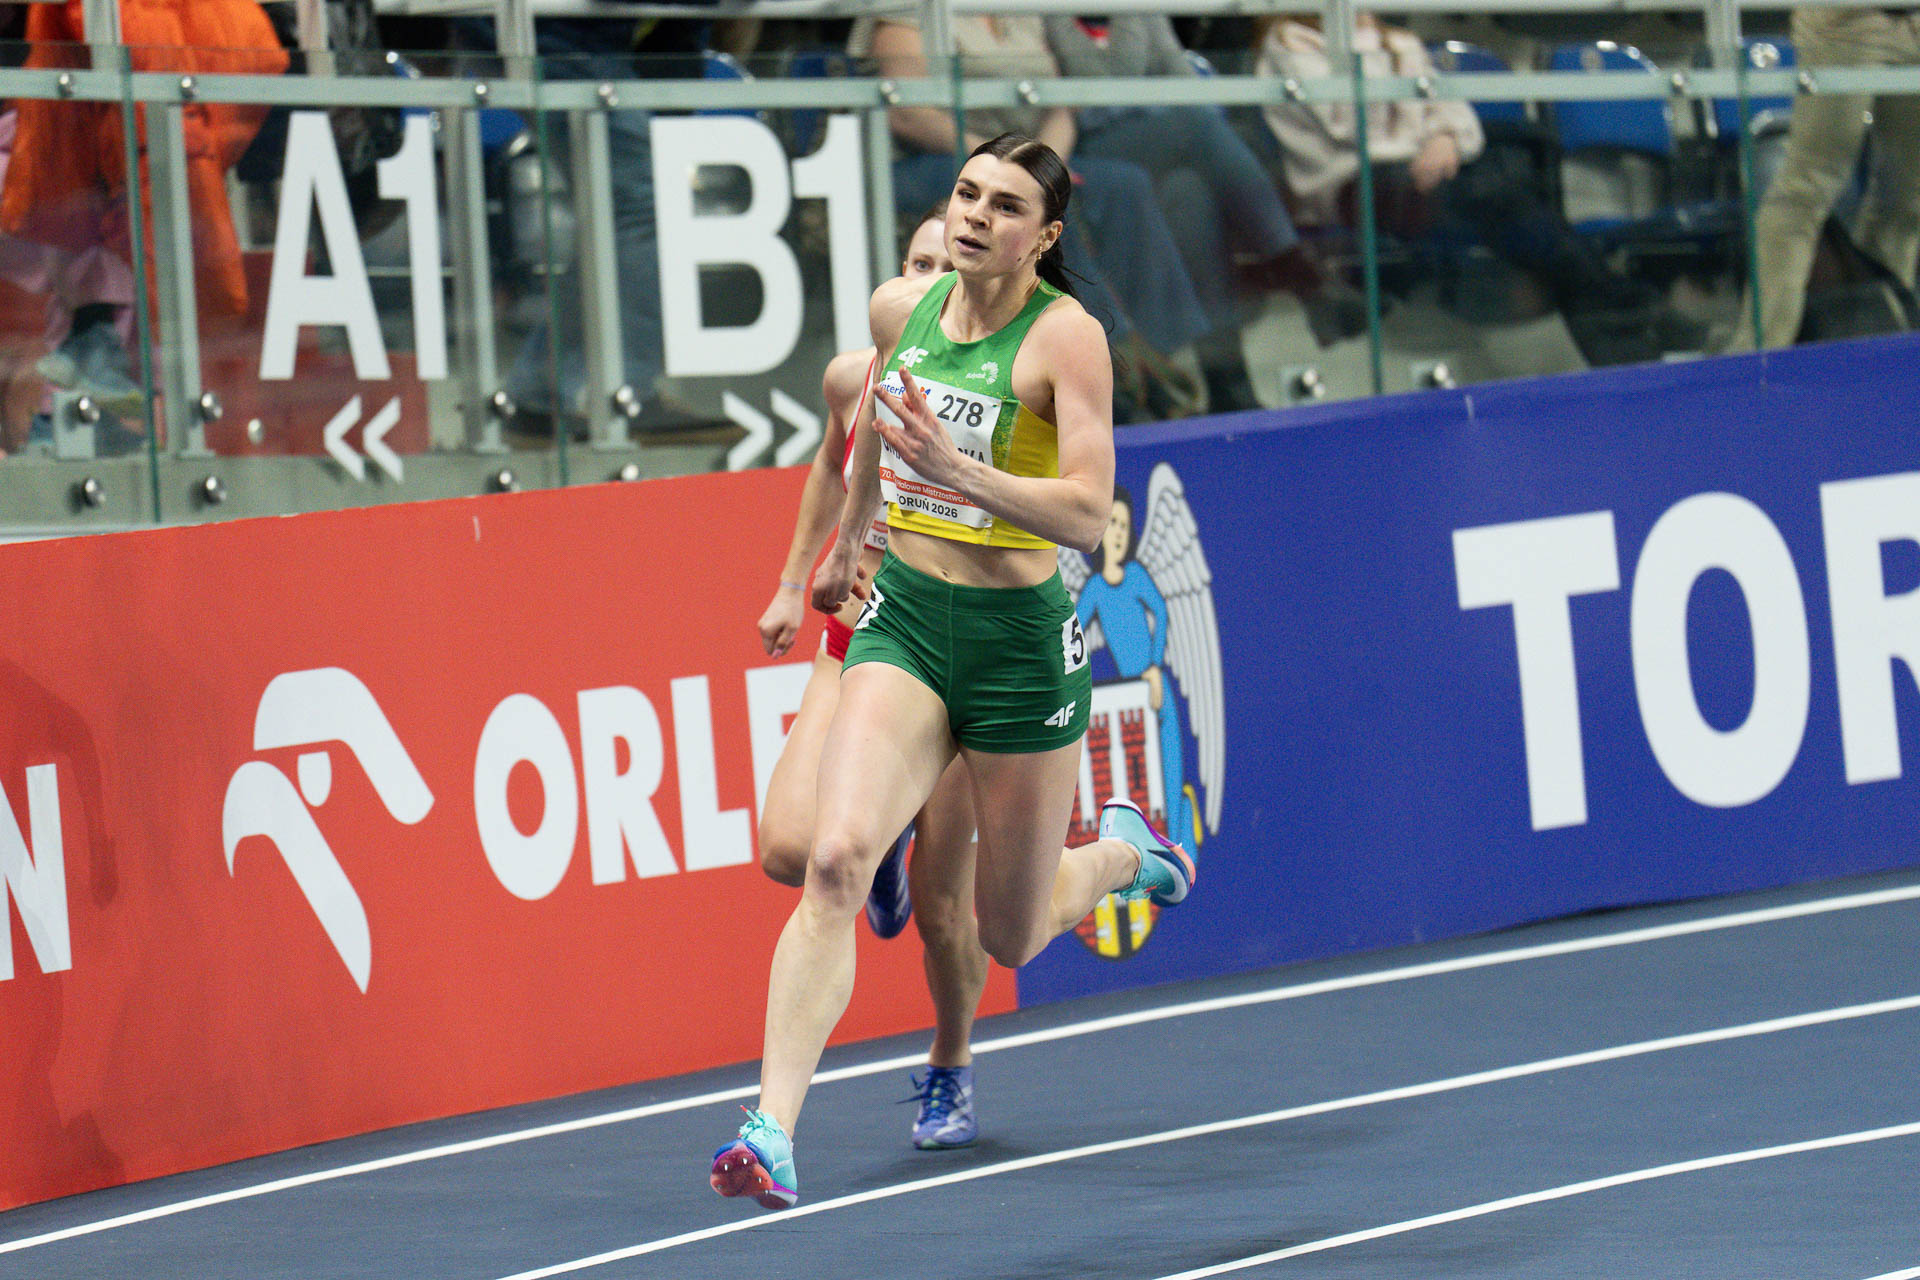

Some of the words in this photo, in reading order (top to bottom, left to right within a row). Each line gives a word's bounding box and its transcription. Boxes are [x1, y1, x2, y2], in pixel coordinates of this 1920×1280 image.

[259, 111, 448, 381] A1
[650, 114, 873, 378] B1
[897, 345, 929, 368] 4F
[936, 394, 984, 428] 278
[896, 494, 929, 511] ORUŃ
[931, 503, 958, 518] 2026
[922, 486, 964, 503] Mistrzostwa
[1070, 617, 1084, 666] 5
[1044, 700, 1077, 727] 4F
[473, 661, 978, 901] ORLE
